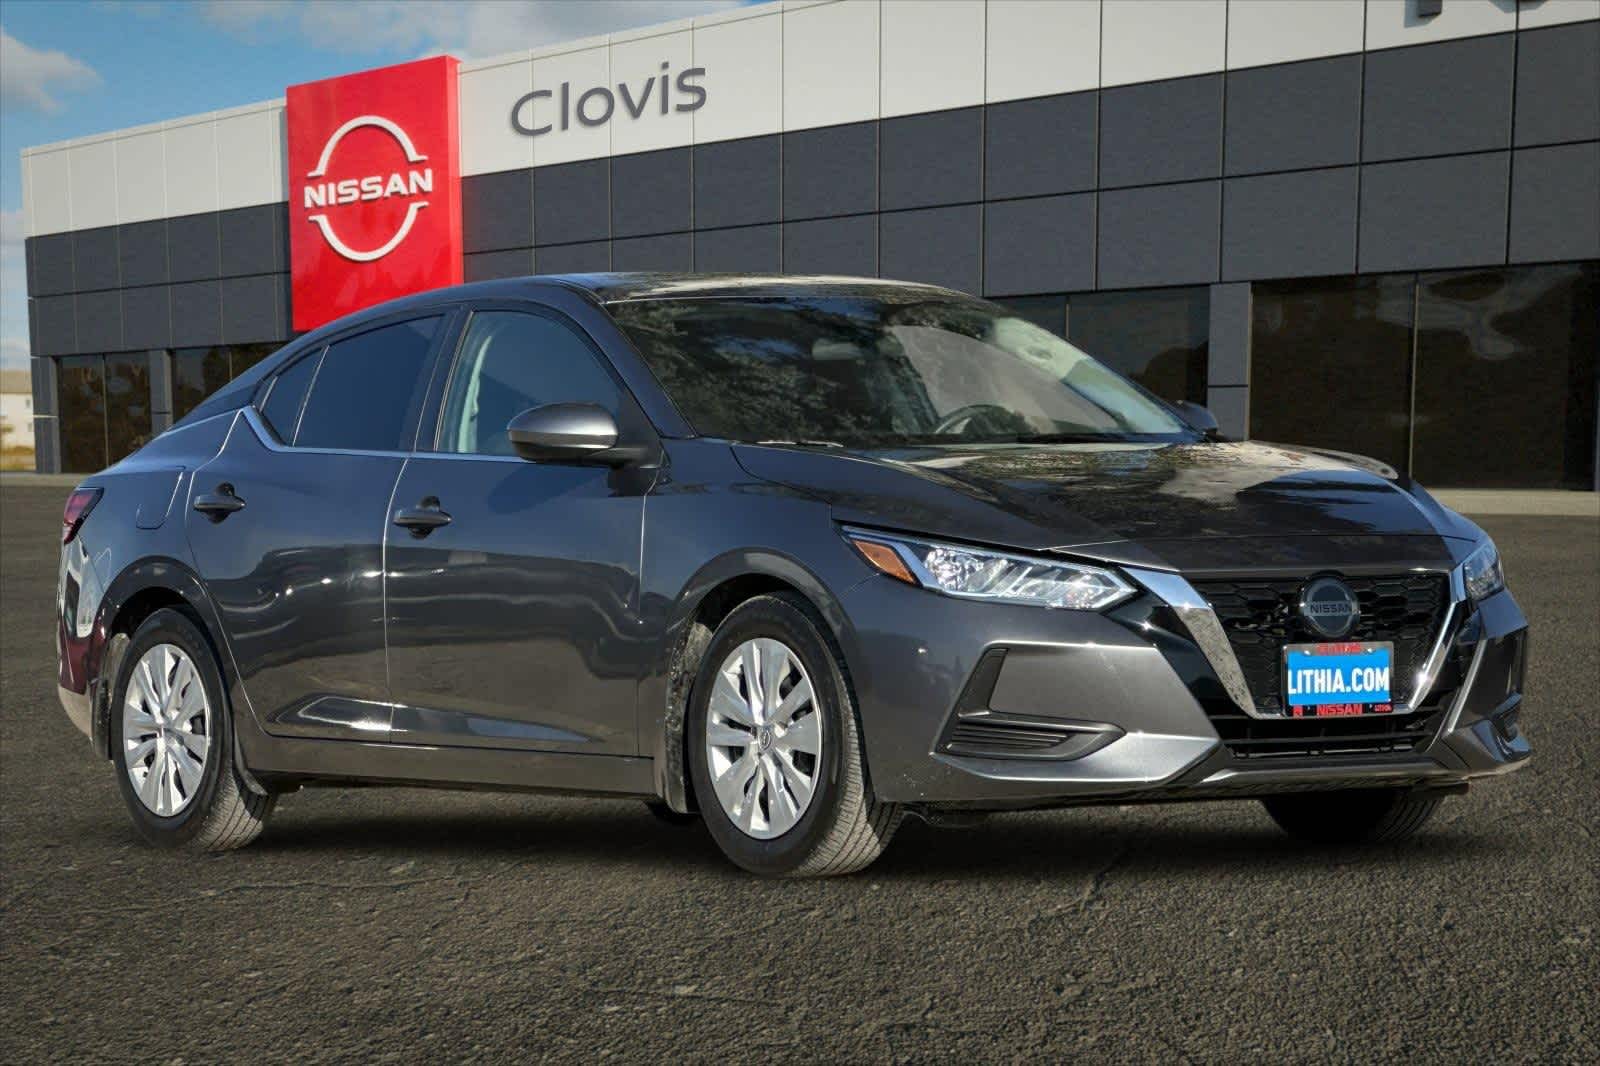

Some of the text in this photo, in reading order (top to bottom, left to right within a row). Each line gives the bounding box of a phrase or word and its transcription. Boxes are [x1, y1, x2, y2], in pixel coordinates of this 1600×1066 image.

[511, 62, 707, 136] Clovis
[304, 168, 432, 208] NISSAN
[1310, 604, 1351, 614] NISSAN
[1288, 667, 1390, 694] LITHIA.COM
[1317, 704, 1362, 715] NISSAN
